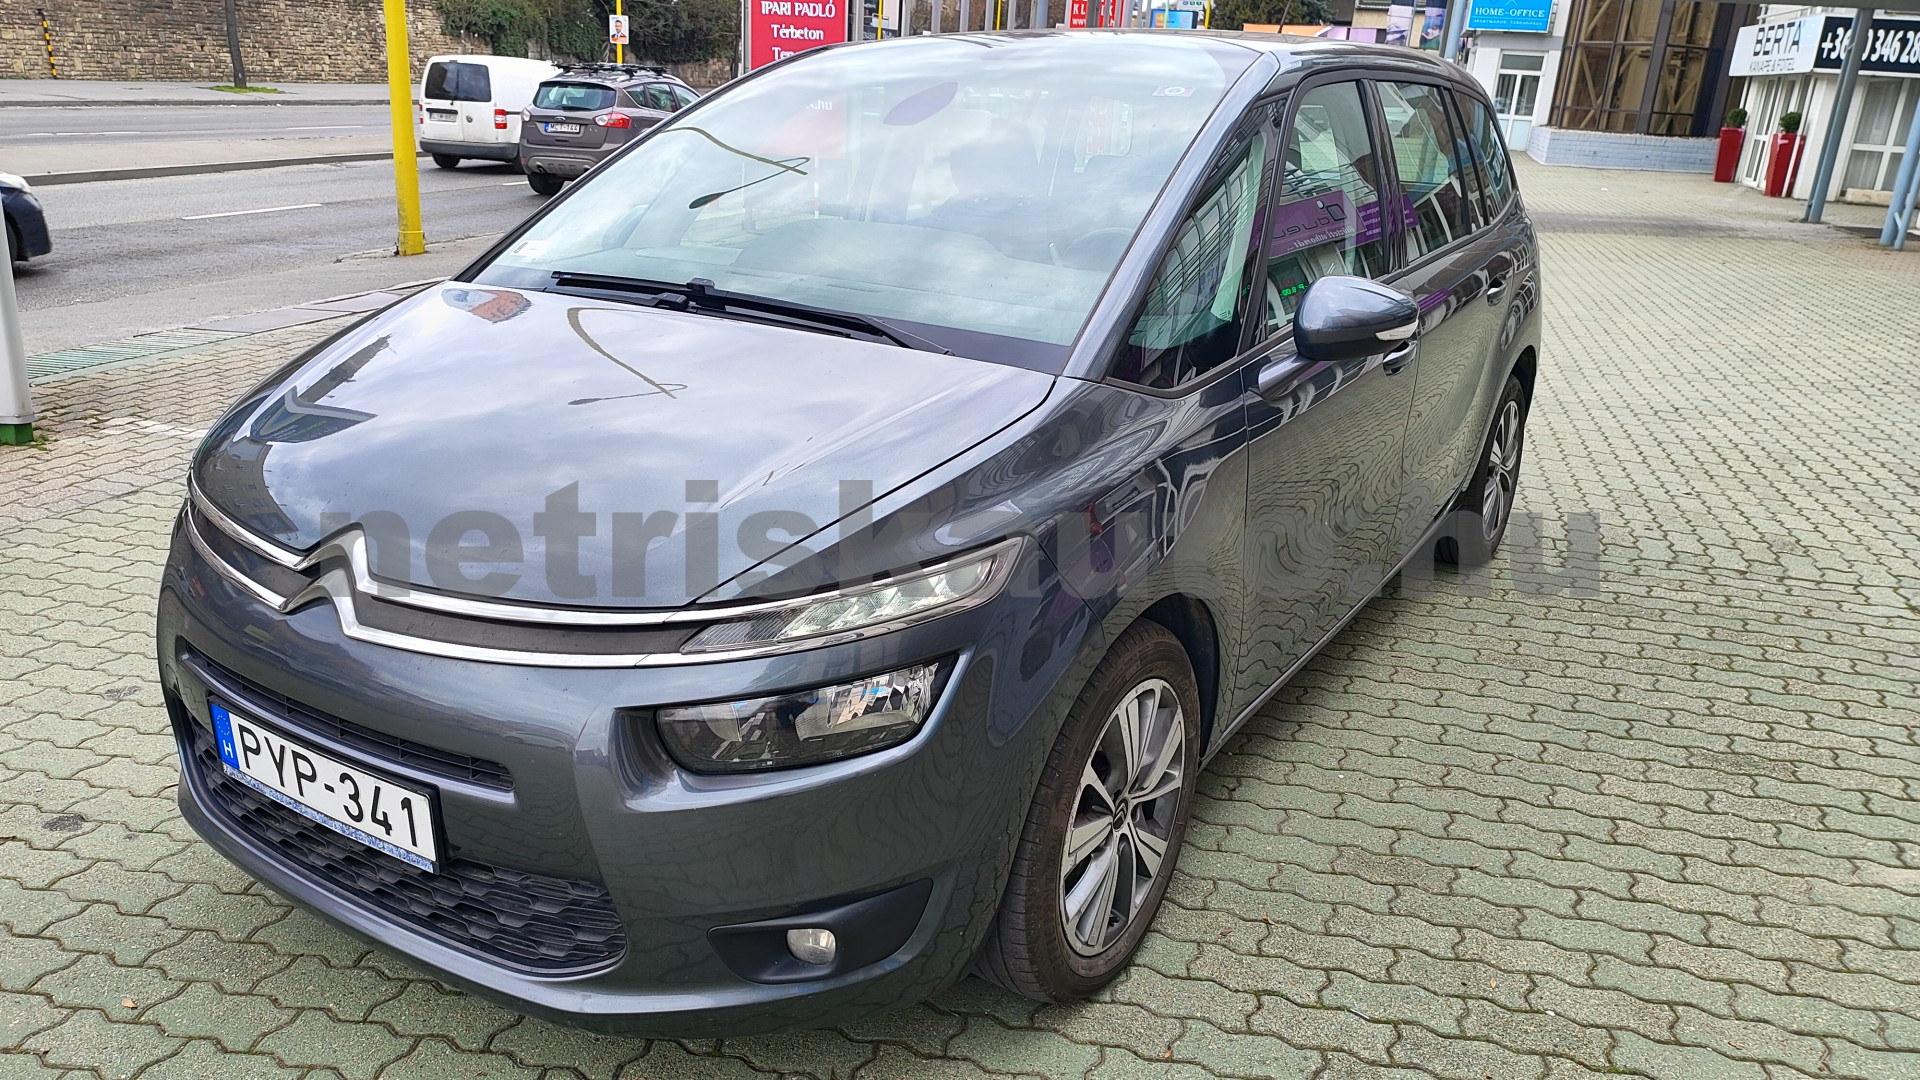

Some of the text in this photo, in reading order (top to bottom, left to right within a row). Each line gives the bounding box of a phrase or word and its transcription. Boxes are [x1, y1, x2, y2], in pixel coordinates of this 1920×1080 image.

[761, 0, 836, 18] IPARI PADLÓ
[1475, 7, 1545, 17] HOME-OFFICE
[770, 23, 824, 41] Térbeton
[1753, 20, 1802, 57] BERTA
[223, 739, 233, 758] H
[237, 722, 418, 848] PYP-341
